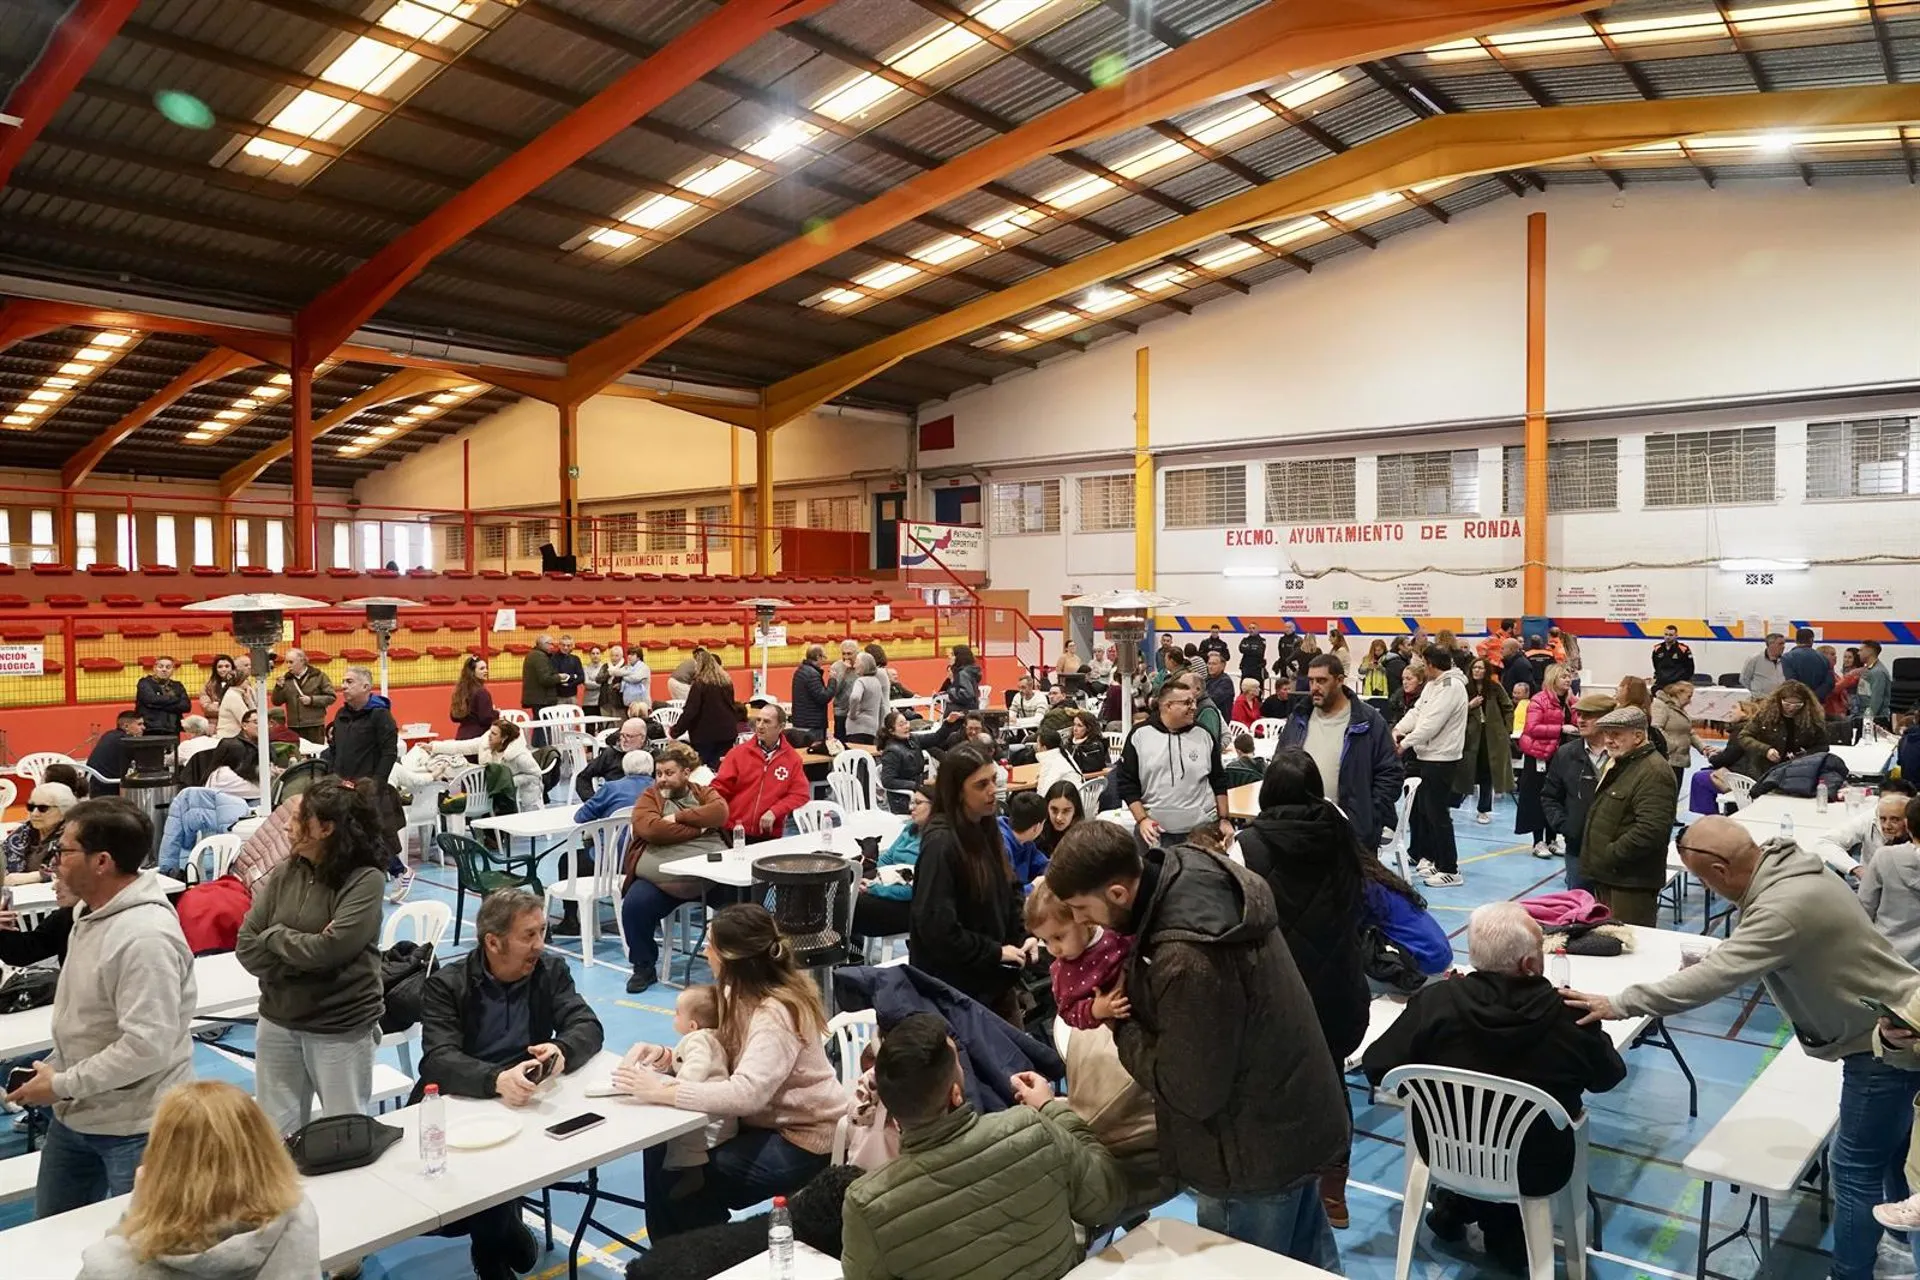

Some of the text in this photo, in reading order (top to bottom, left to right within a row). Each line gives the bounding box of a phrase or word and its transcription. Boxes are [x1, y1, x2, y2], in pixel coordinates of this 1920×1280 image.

[1226, 520, 1521, 546] EXCMO. AYUNTAMIENTO DE RONDA
[616, 554, 663, 567] AYUNTAMIENTO
[670, 556, 679, 566] DE
